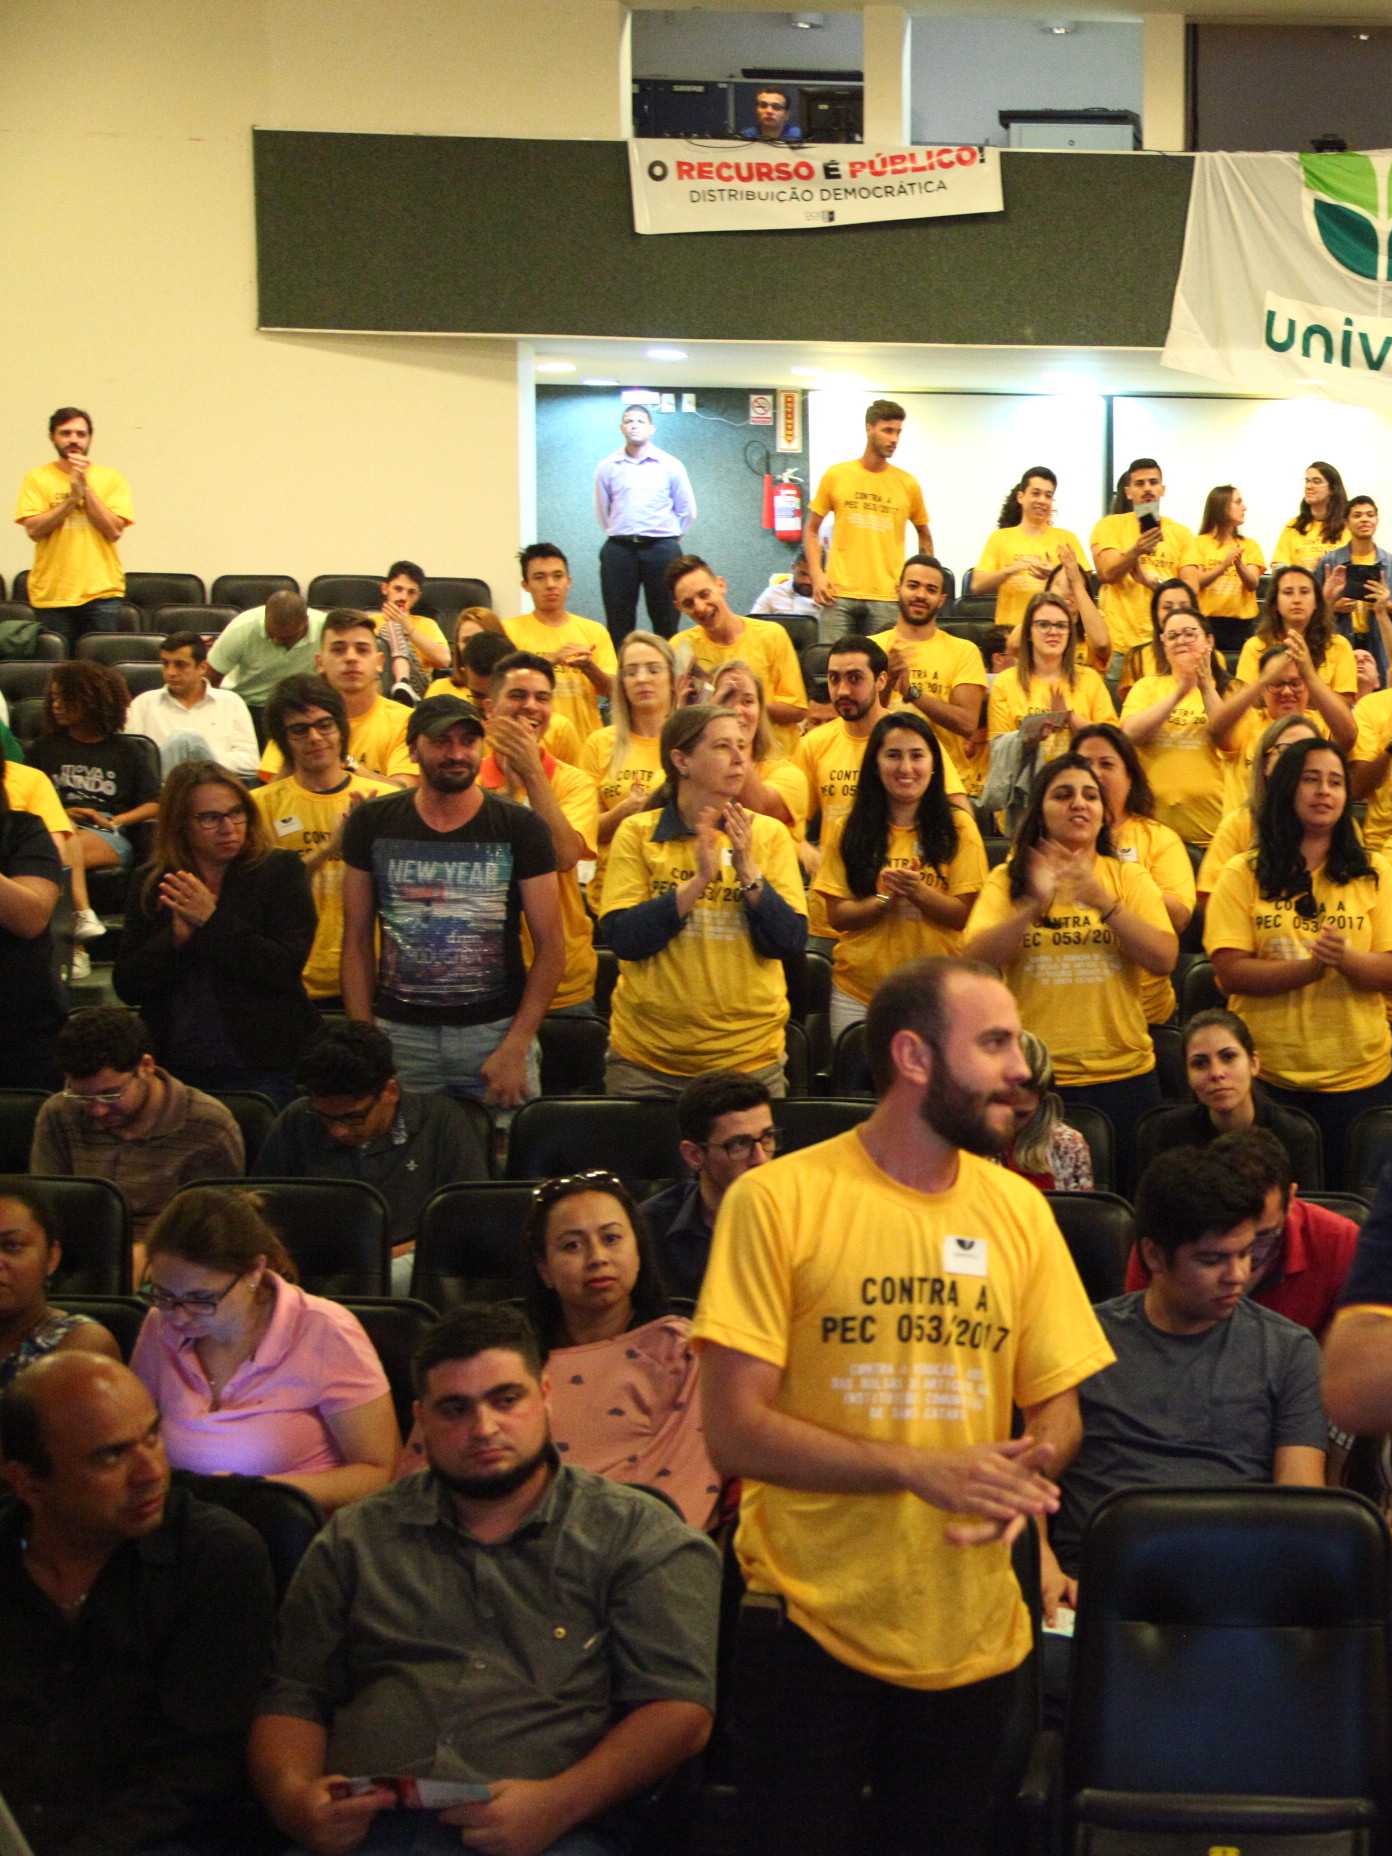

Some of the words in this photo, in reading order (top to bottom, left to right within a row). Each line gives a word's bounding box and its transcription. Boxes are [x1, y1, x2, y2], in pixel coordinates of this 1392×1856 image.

[648, 160, 668, 182] O
[676, 160, 815, 183] RECURSO
[823, 157, 842, 180] É
[849, 146, 987, 179] PÚBLICO!
[689, 186, 814, 204] DISTRIBUIÇÃO
[820, 180, 948, 203] DEMOCRÁTICA
[830, 769, 860, 781] CONT
[387, 858, 439, 884] NEW
[444, 861, 500, 886] YEAR
[1256, 915, 1282, 930] PEC
[1021, 931, 1043, 948] EC
[861, 1276, 960, 1308] CONTRA
[975, 1285, 988, 1312] A
[821, 1315, 876, 1344] PEC
[897, 1314, 1011, 1353] 053/2017
